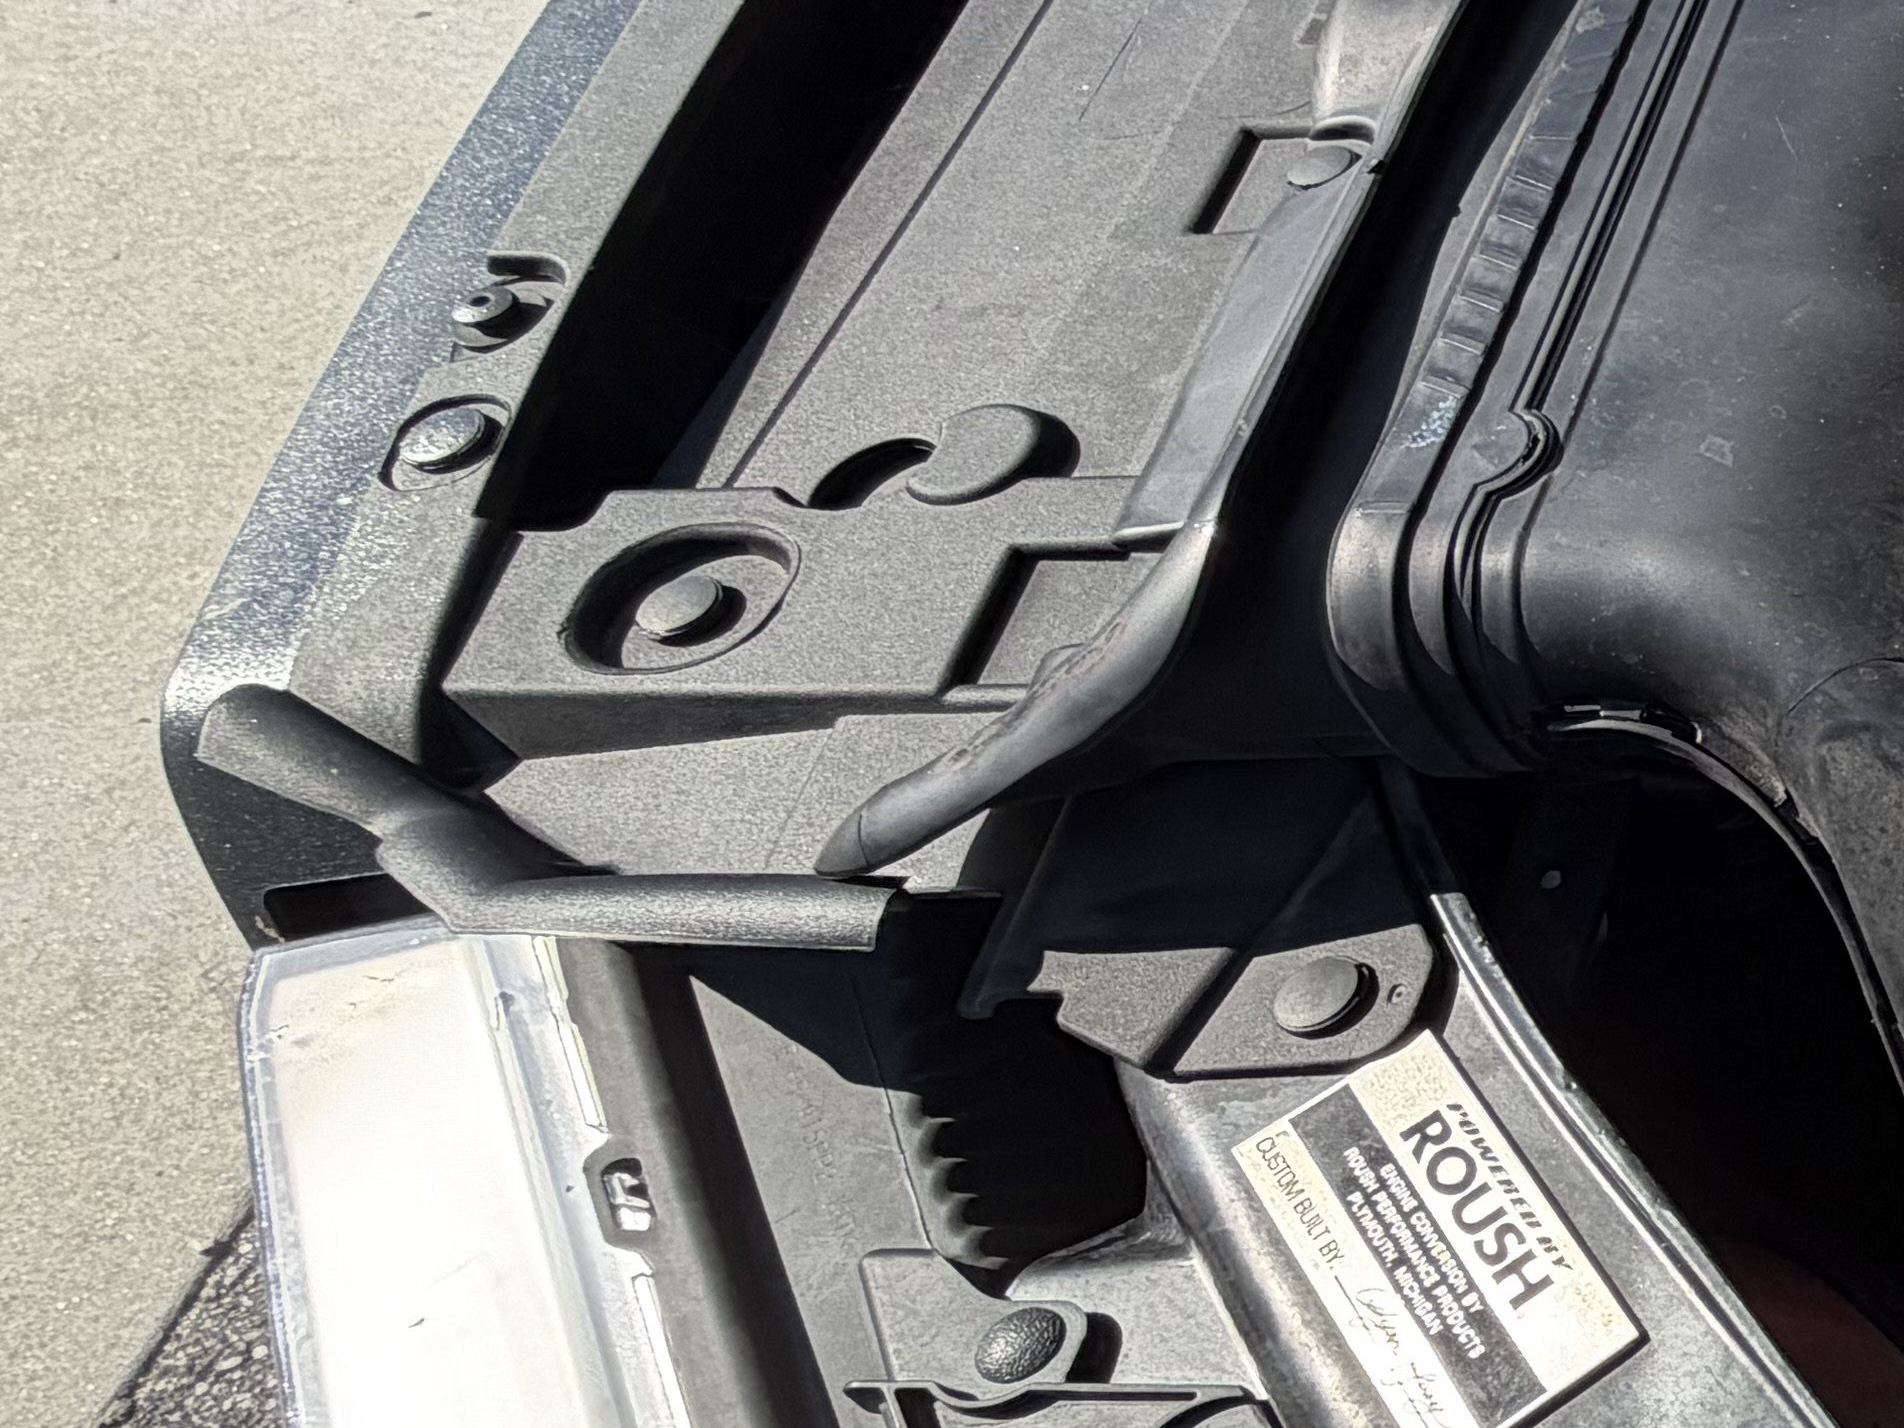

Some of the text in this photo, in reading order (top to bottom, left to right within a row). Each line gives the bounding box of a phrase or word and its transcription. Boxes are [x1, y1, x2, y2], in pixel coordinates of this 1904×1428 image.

[1255, 1135, 1306, 1203] CUSTOM
[1293, 1196, 1331, 1241] BUILT
[1343, 1146, 1381, 1193] ROUSH
[1370, 1190, 1440, 1288] PERFORMANCE
[1431, 1284, 1486, 1360] PRODUCTS
[1380, 1162, 1484, 1313] ENGINE CONVERSION BY
[1399, 1109, 1555, 1310] ROUSH
[1446, 1103, 1574, 1271] POWERED BY
[1393, 1265, 1443, 1336] MICHIGAN
